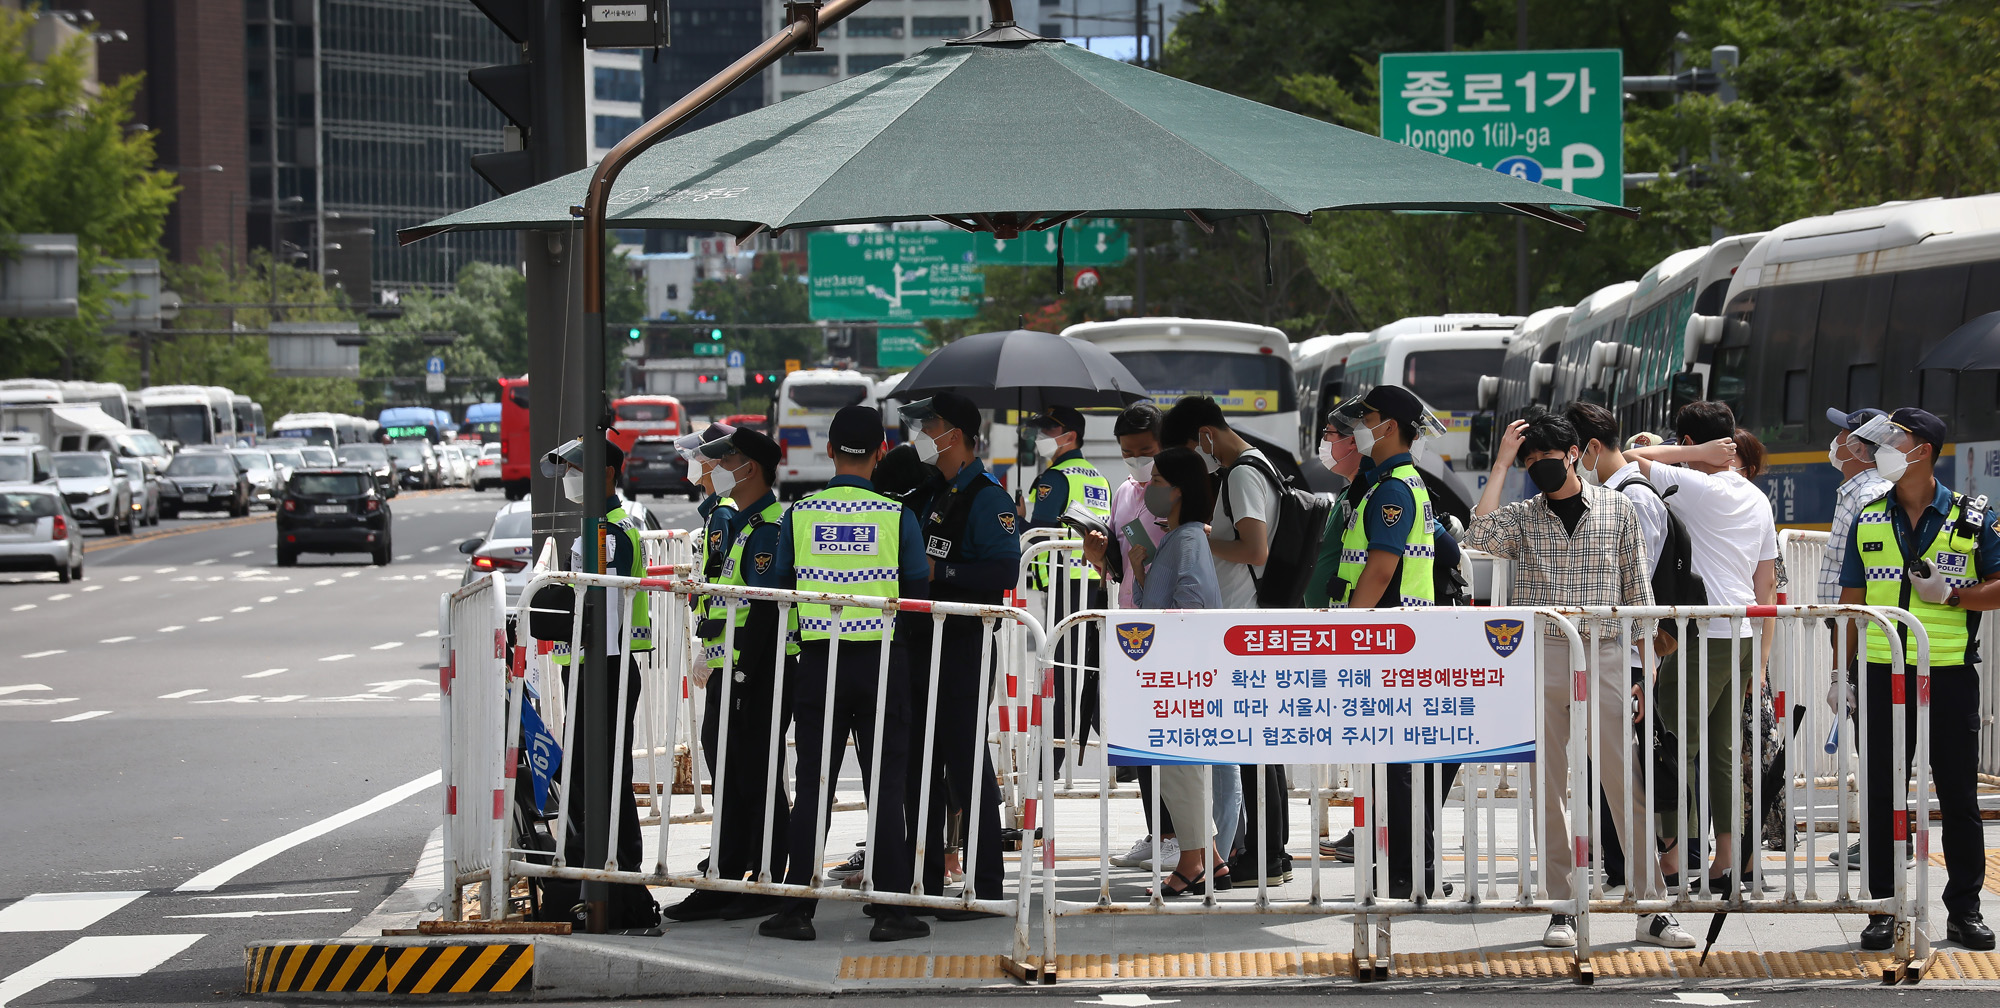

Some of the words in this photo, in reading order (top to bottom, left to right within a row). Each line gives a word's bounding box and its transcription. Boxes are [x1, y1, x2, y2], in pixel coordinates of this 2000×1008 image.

[1401, 67, 1596, 116] 종로1가
[1400, 123, 1475, 154] Jongno
[1482, 121, 1551, 153] 1(il)-ga
[1510, 161, 1528, 180] 6
[843, 446, 864, 455] POLICE
[1086, 487, 1107, 501] 경찰
[1087, 500, 1107, 508] POLICE
[820, 526, 871, 542] 경찰
[819, 543, 870, 552] POLICE
[931, 538, 949, 550] 경찰
[929, 548, 946, 556] POLICE
[1939, 552, 1965, 566] 경찰
[1937, 565, 1963, 573] POLICE
[1243, 629, 1336, 651] 집회금지
[1350, 628, 1396, 651] 안내
[1231, 669, 1267, 689] 확산
[1275, 669, 1328, 688] 방지를
[1337, 668, 1372, 688] 위해
[1381, 667, 1505, 687] 감염병예방법과
[1153, 699, 1223, 718] 집시법에
[1233, 698, 1268, 717] 따라
[1422, 697, 1476, 716] 집회를
[1148, 727, 1252, 747] 금지하였으니
[1262, 727, 1332, 746] 협조하여
[1342, 726, 1394, 745] 주시기
[1404, 726, 1480, 745] 바랍니다.
